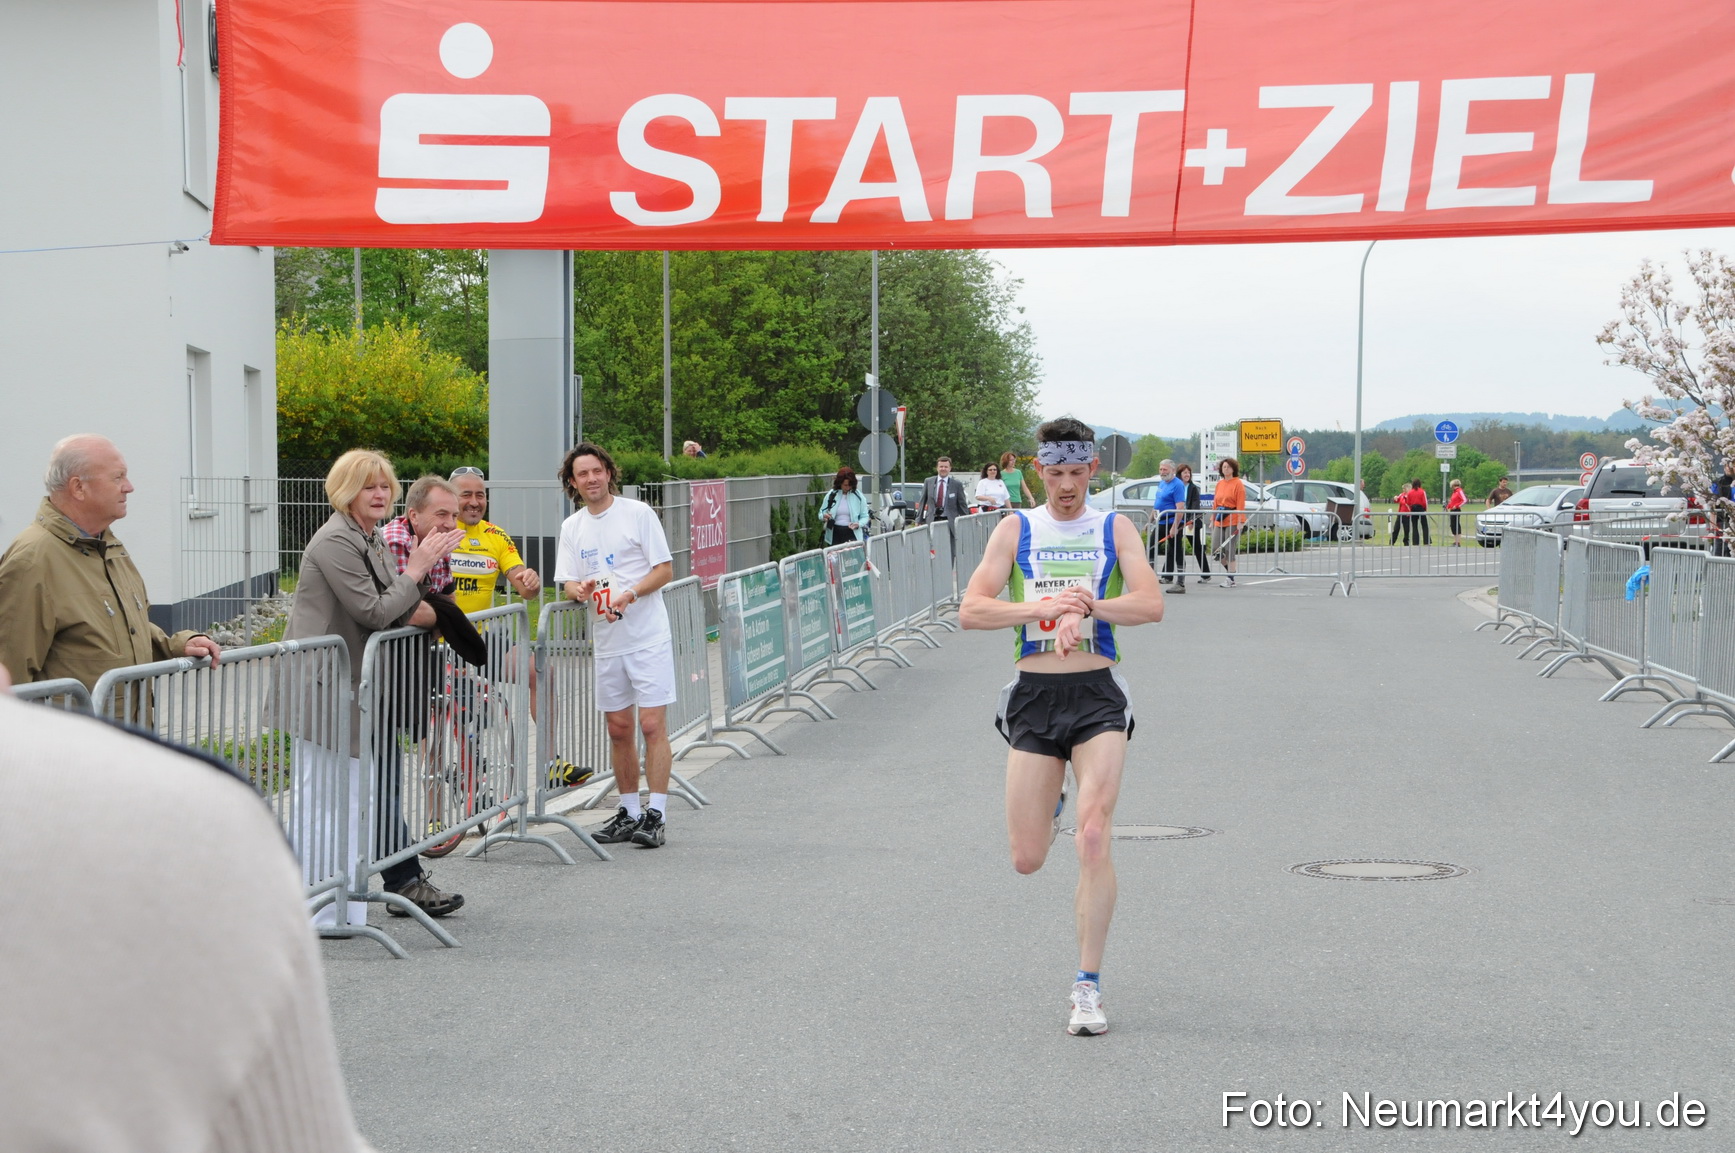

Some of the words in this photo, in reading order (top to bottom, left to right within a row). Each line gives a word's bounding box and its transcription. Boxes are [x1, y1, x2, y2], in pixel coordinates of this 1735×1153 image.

[1244, 432, 1278, 440] Neumarkt
[1584, 457, 1594, 466] 60
[1037, 550, 1099, 561] BOCK
[1035, 579, 1065, 589] MEYER
[593, 588, 611, 615] 27
